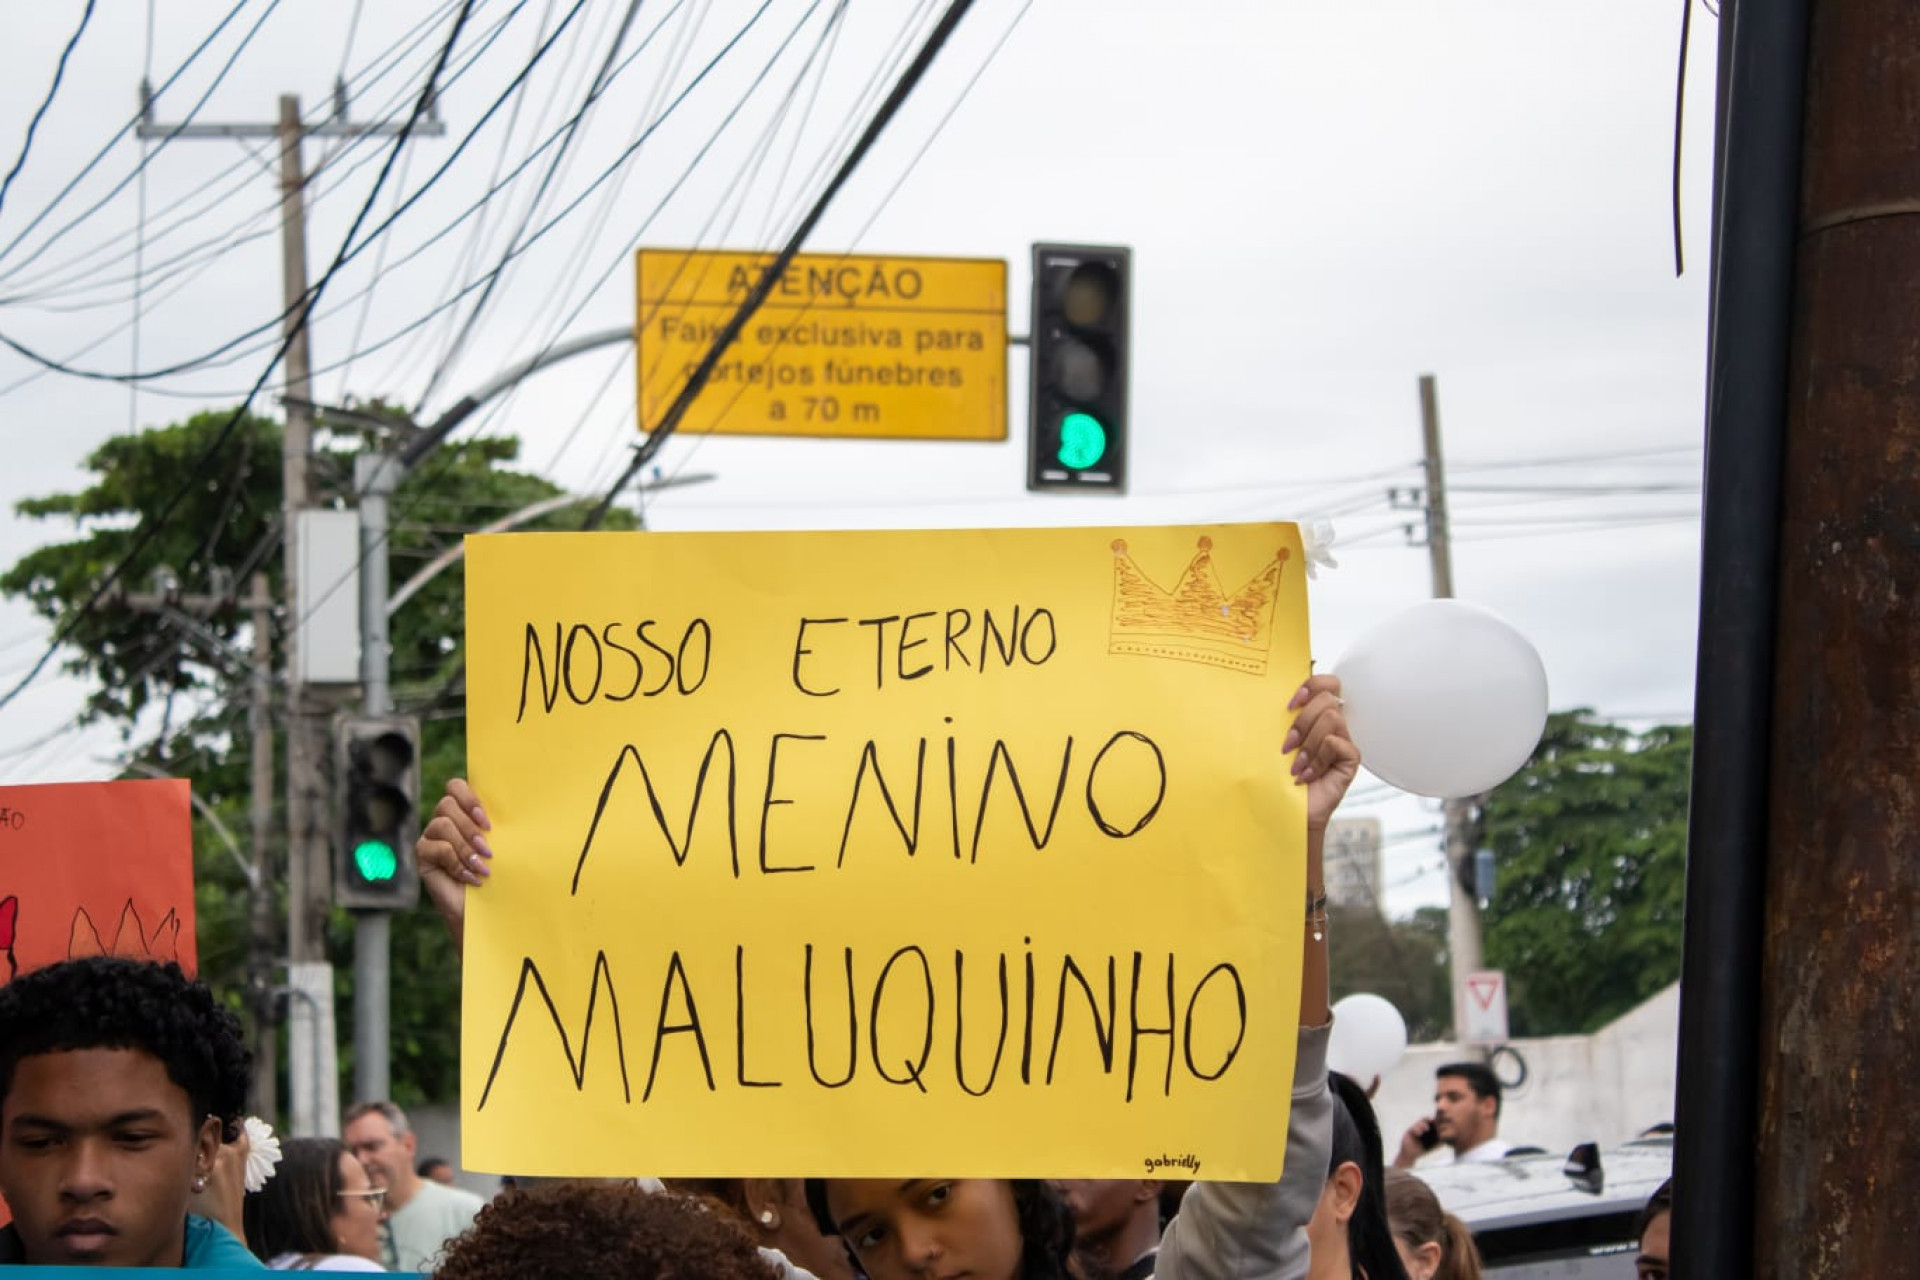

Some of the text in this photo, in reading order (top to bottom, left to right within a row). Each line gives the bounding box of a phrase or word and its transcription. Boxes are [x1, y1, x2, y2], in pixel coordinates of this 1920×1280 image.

[757, 322, 902, 348] exclusiva
[915, 328, 983, 355] para
[824, 357, 964, 388] fúnebres
[769, 396, 881, 423] a 70 m
[516, 604, 1058, 724] NOSSO ETERNO
